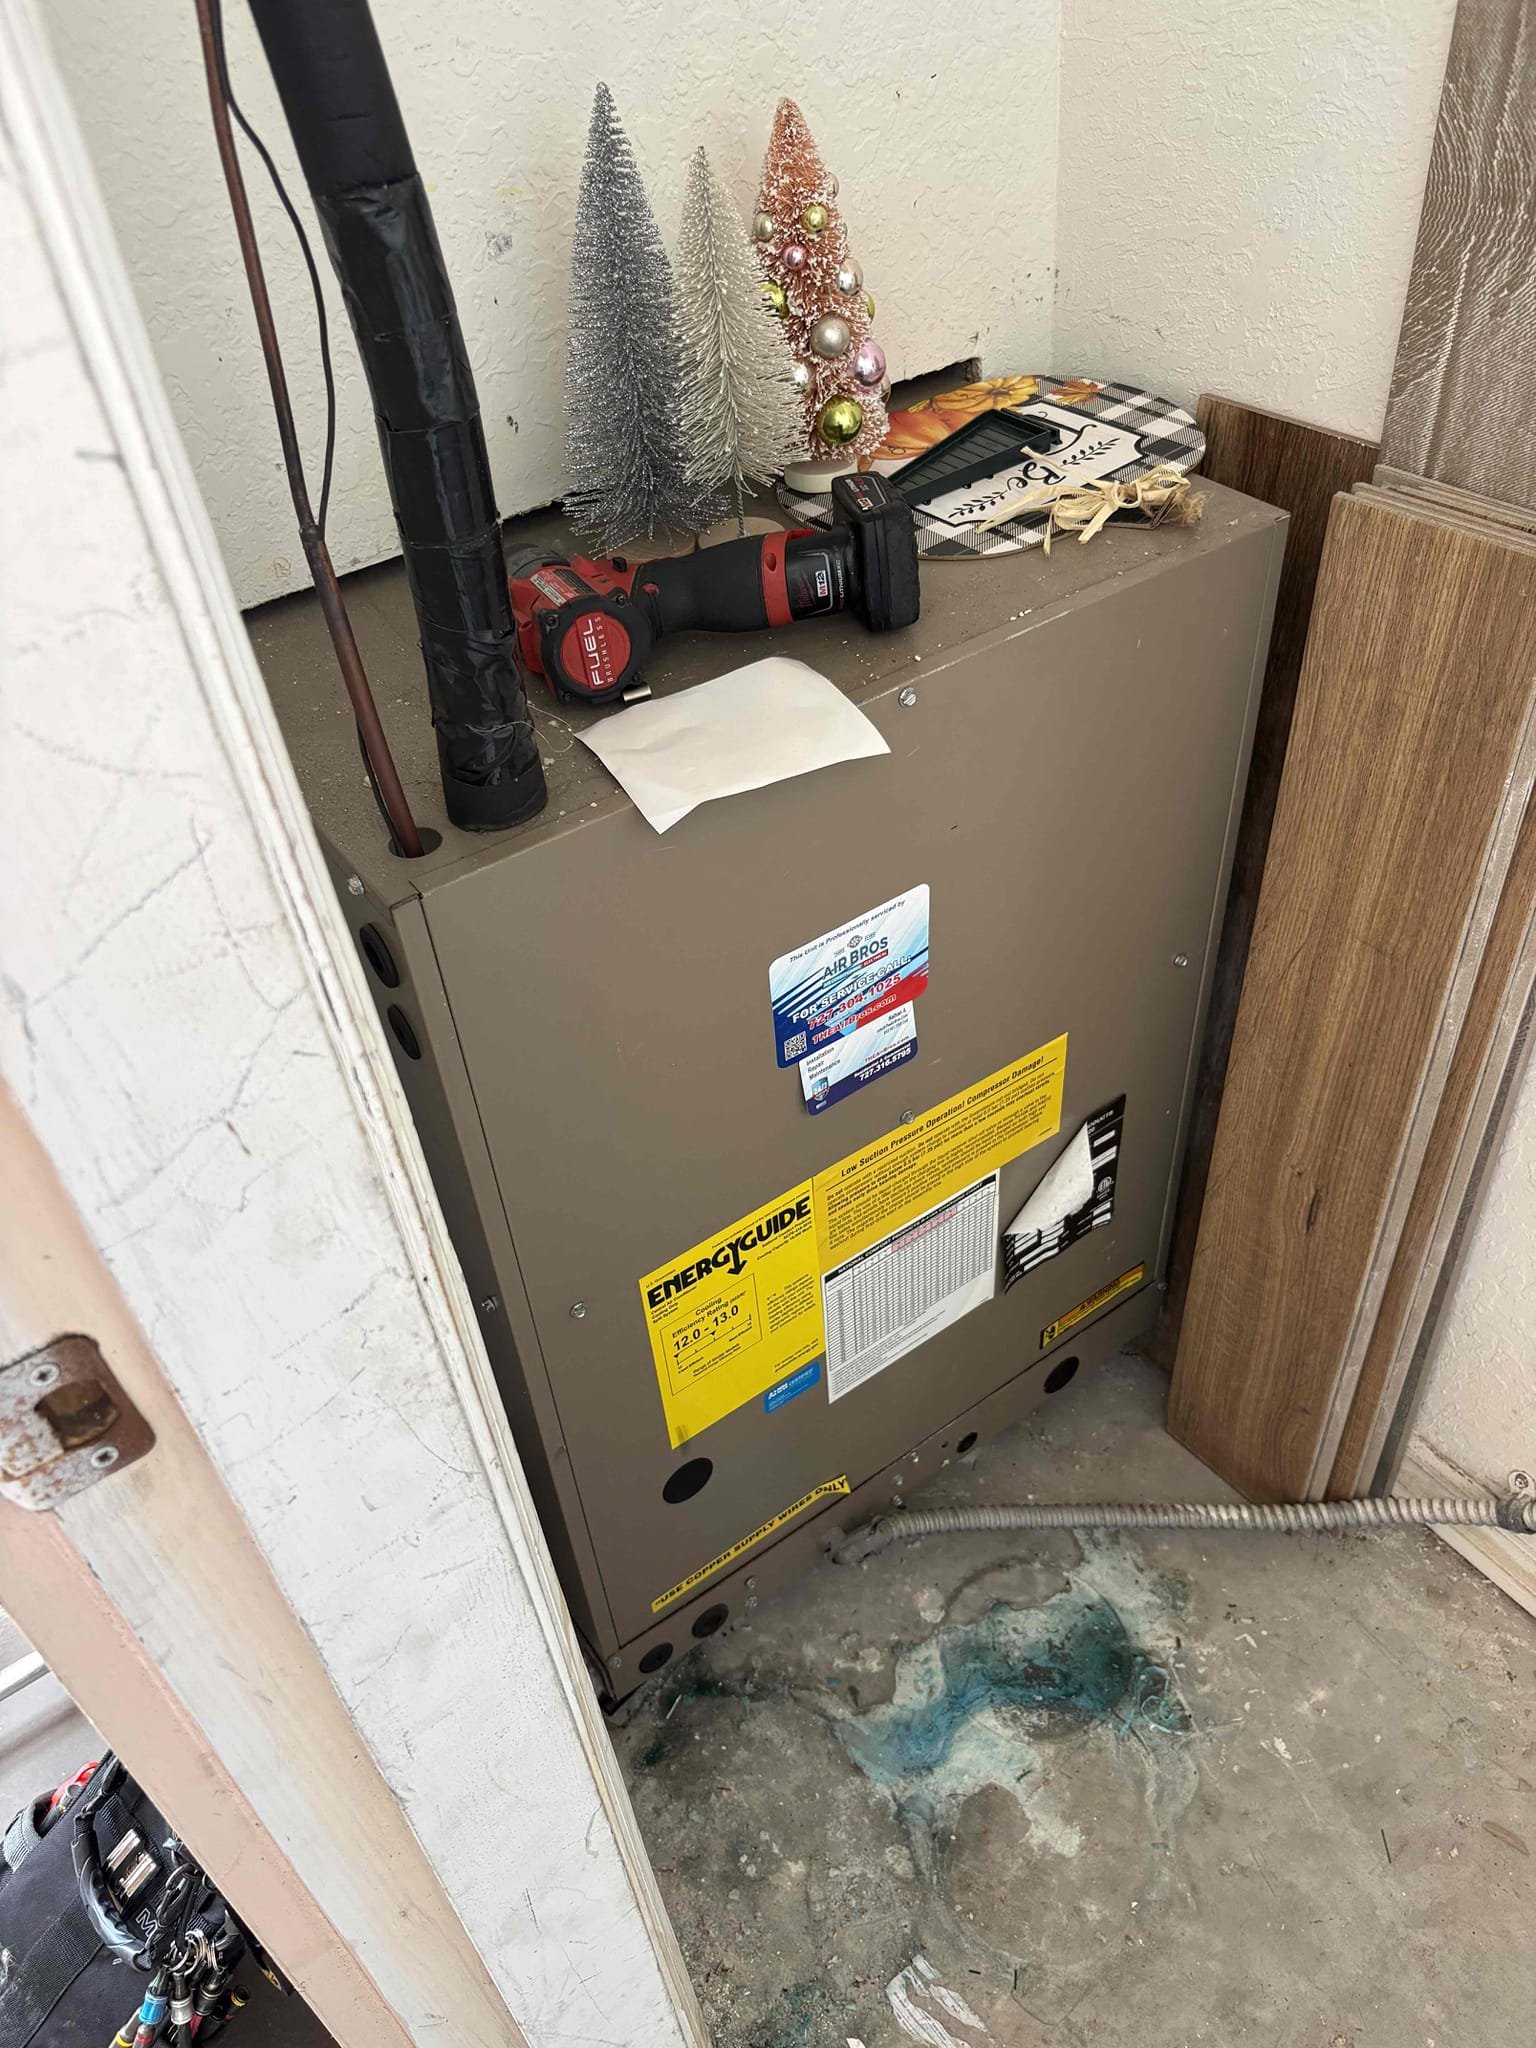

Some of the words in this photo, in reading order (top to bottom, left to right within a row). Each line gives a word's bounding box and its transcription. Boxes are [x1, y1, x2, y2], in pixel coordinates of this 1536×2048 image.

[1007, 461, 1066, 491] Be
[816, 570, 828, 597] M12
[583, 619, 604, 685] FUEL
[595, 616, 614, 683] BRUSHLESS
[789, 950, 803, 963] This
[804, 943, 817, 955] Unit
[818, 940, 824, 948] is
[825, 916, 869, 945] Professionally
[870, 903, 896, 921] serviced
[896, 898, 905, 908] by
[822, 956, 847, 980] AIR
[850, 936, 888, 966] BROS
[792, 1001, 820, 1024] FOR
[820, 971, 874, 1008] SERVICE
[876, 951, 911, 979] CALL:
[807, 972, 900, 1031] 727.304.1025
[805, 1045, 834, 1065] Installation
[806, 1059, 825, 1073] Repair
[808, 1058, 840, 1080] Maintenance
[840, 1162, 857, 1178] Low
[858, 1143, 888, 1167] Suction
[890, 1123, 923, 1149] Pressure
[925, 1099, 965, 1130] Operation!
[966, 1073, 1010, 1106] Compressor
[1011, 1054, 1044, 1081] Damage!
[646, 1194, 811, 1309] ENERGYGUIDE
[671, 1314, 704, 1339] Efficiency
[706, 1299, 729, 1318] Rating
[672, 1326, 701, 1352] 12.0
[711, 1302, 739, 1329] 13.0
[694, 1295, 722, 1317] Cooling
[686, 1552, 732, 1586] COPPER
[733, 1520, 776, 1553] SUPPLY
[778, 1495, 812, 1522] WIRES
[814, 1479, 848, 1496] ONLY
